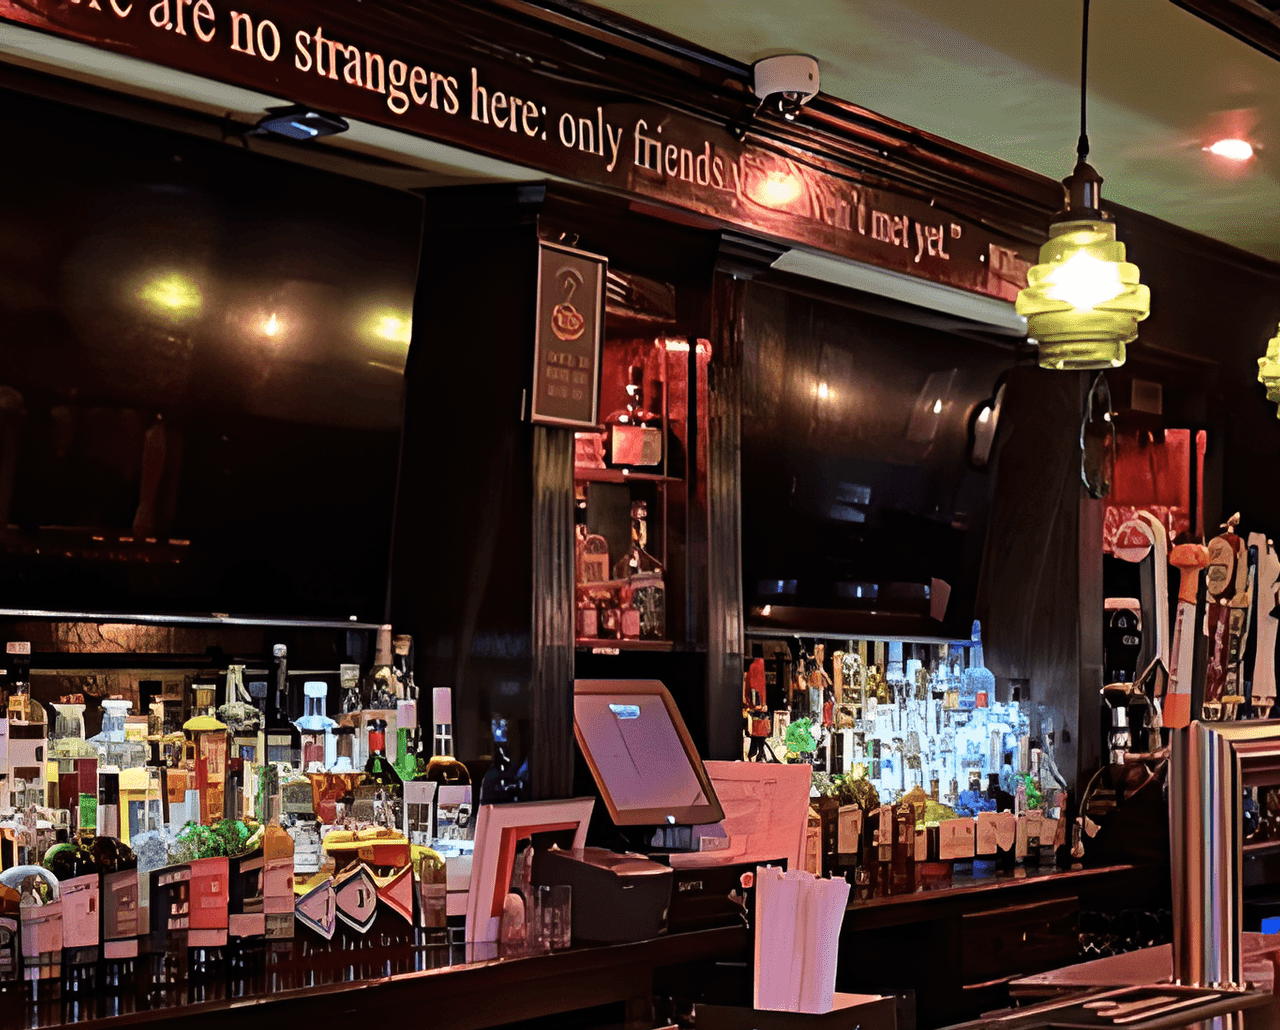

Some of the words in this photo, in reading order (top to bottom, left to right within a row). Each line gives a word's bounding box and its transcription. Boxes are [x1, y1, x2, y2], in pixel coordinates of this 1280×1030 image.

[149, 0, 216, 42] are
[230, 10, 280, 61] no
[294, 26, 460, 115] strangers
[559, 106, 623, 173] only
[634, 118, 724, 190] friends
